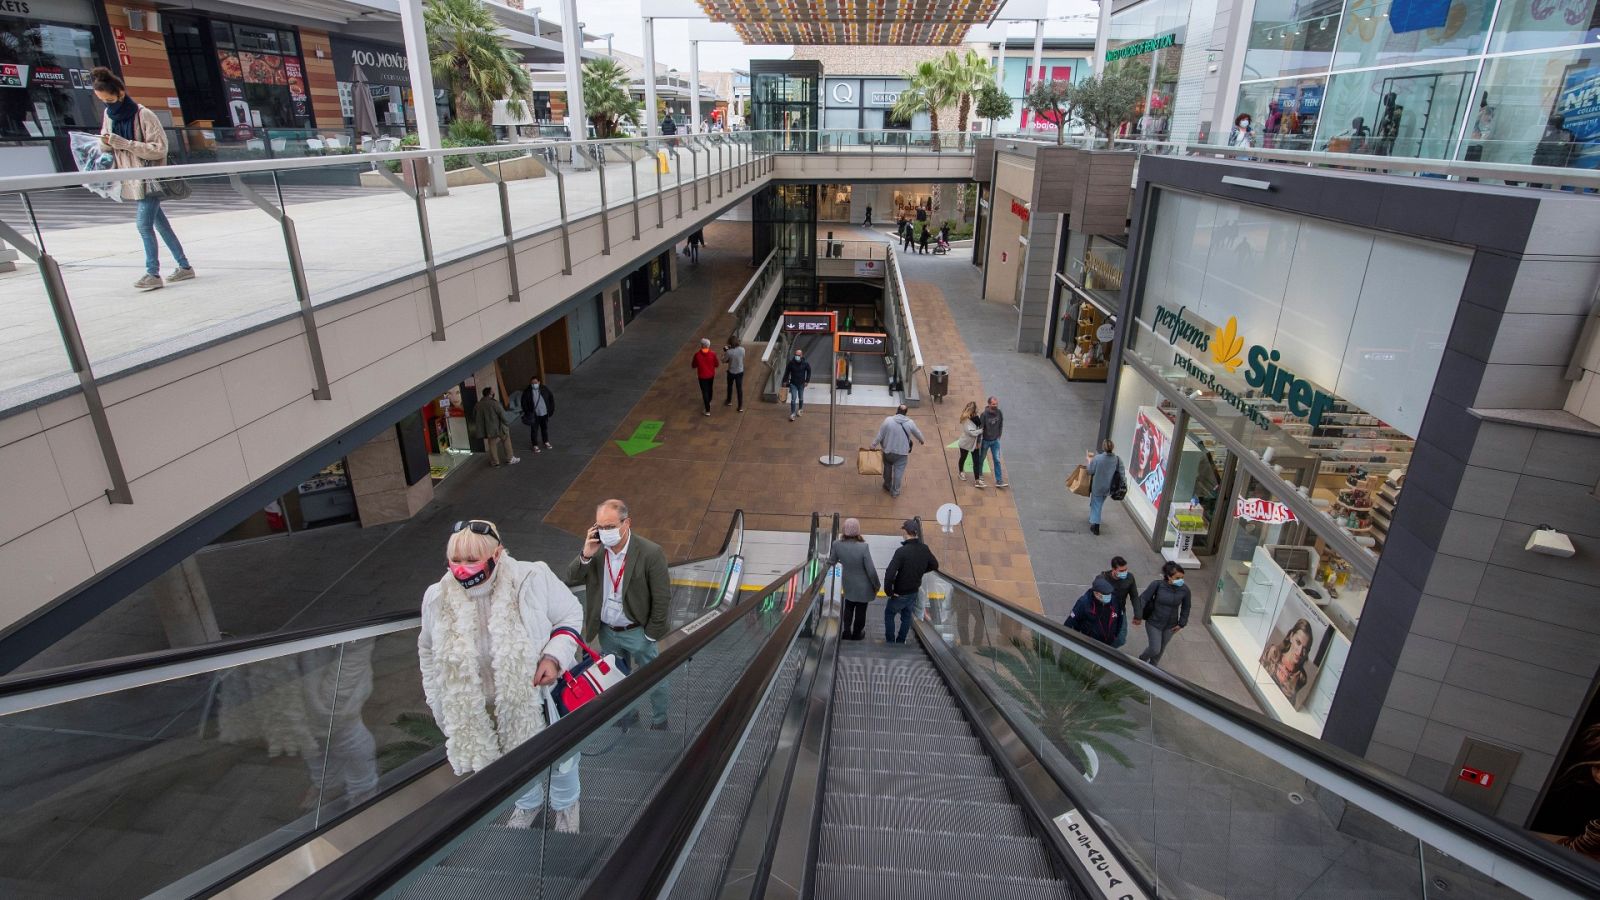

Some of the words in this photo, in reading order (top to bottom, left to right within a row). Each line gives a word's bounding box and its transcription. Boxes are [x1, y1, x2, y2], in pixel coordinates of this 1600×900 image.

[0, 1, 30, 13] KETS
[351, 50, 375, 67] 100
[376, 52, 409, 71] MONTA
[35, 72, 65, 80] ARTESIETE
[833, 82, 863, 104] Q
[1152, 305, 1211, 353] perfums
[1173, 353, 1208, 385] perfums
[1207, 375, 1216, 392] &
[1215, 383, 1270, 431] cosmetics
[1244, 344, 1336, 428] Sirer
[1237, 499, 1289, 521] REBAJAS
[1067, 823, 1123, 889] DISTANCIA
